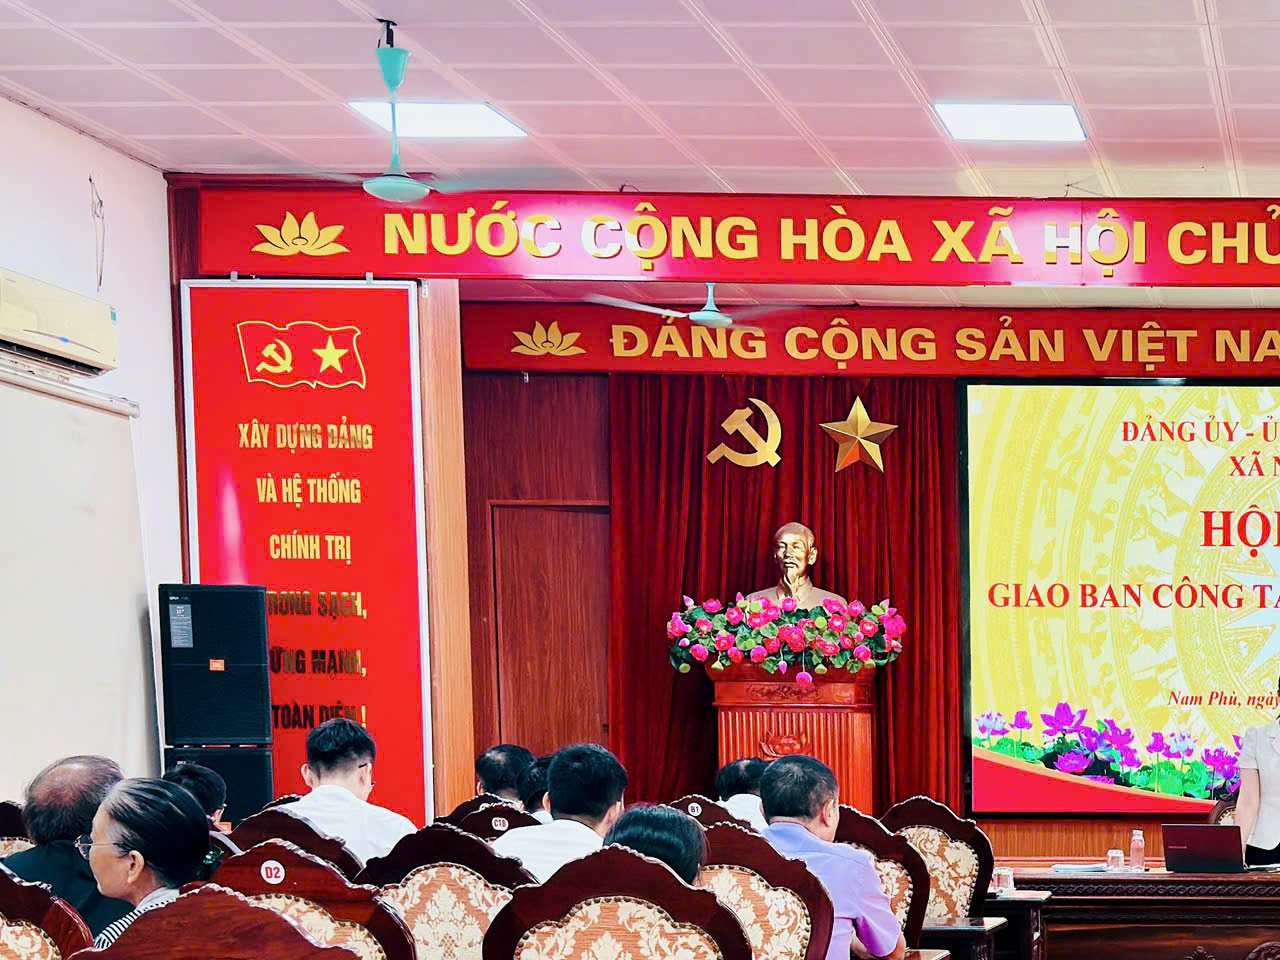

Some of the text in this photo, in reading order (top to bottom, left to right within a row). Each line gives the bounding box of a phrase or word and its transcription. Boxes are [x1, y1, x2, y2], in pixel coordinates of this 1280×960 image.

[384, 200, 560, 258] NƯỚC
[582, 202, 758, 271] CỘNG
[781, 204, 911, 262] HÒA
[934, 207, 1022, 265] XÃ
[1045, 208, 1145, 276] HỘI
[610, 315, 766, 359] ĐẢNG
[784, 318, 937, 369] CỘNG
[955, 316, 1064, 362] SẢN
[1083, 321, 1197, 371] VIỆT
[238, 418, 269, 448] XÂY
[276, 422, 322, 454] DỰNG
[1121, 416, 1195, 443] ĐẢNG
[1205, 416, 1239, 443] ỦY
[1229, 452, 1263, 477] XÃ
[256, 472, 361, 508] VÀ HỆ THỐNG
[269, 530, 351, 565] CHÍNH TRỊ
[266, 591, 367, 620] RONG SẠCH,
[988, 582, 1070, 609] GIAO
[1080, 583, 1144, 609] BAN
[1153, 575, 1244, 610] CÔNG
[270, 645, 305, 674] ỮNG
[1168, 691, 1203, 706] Nam
[1208, 690, 1242, 708] Phù,
[265, 866, 280, 879] D2
